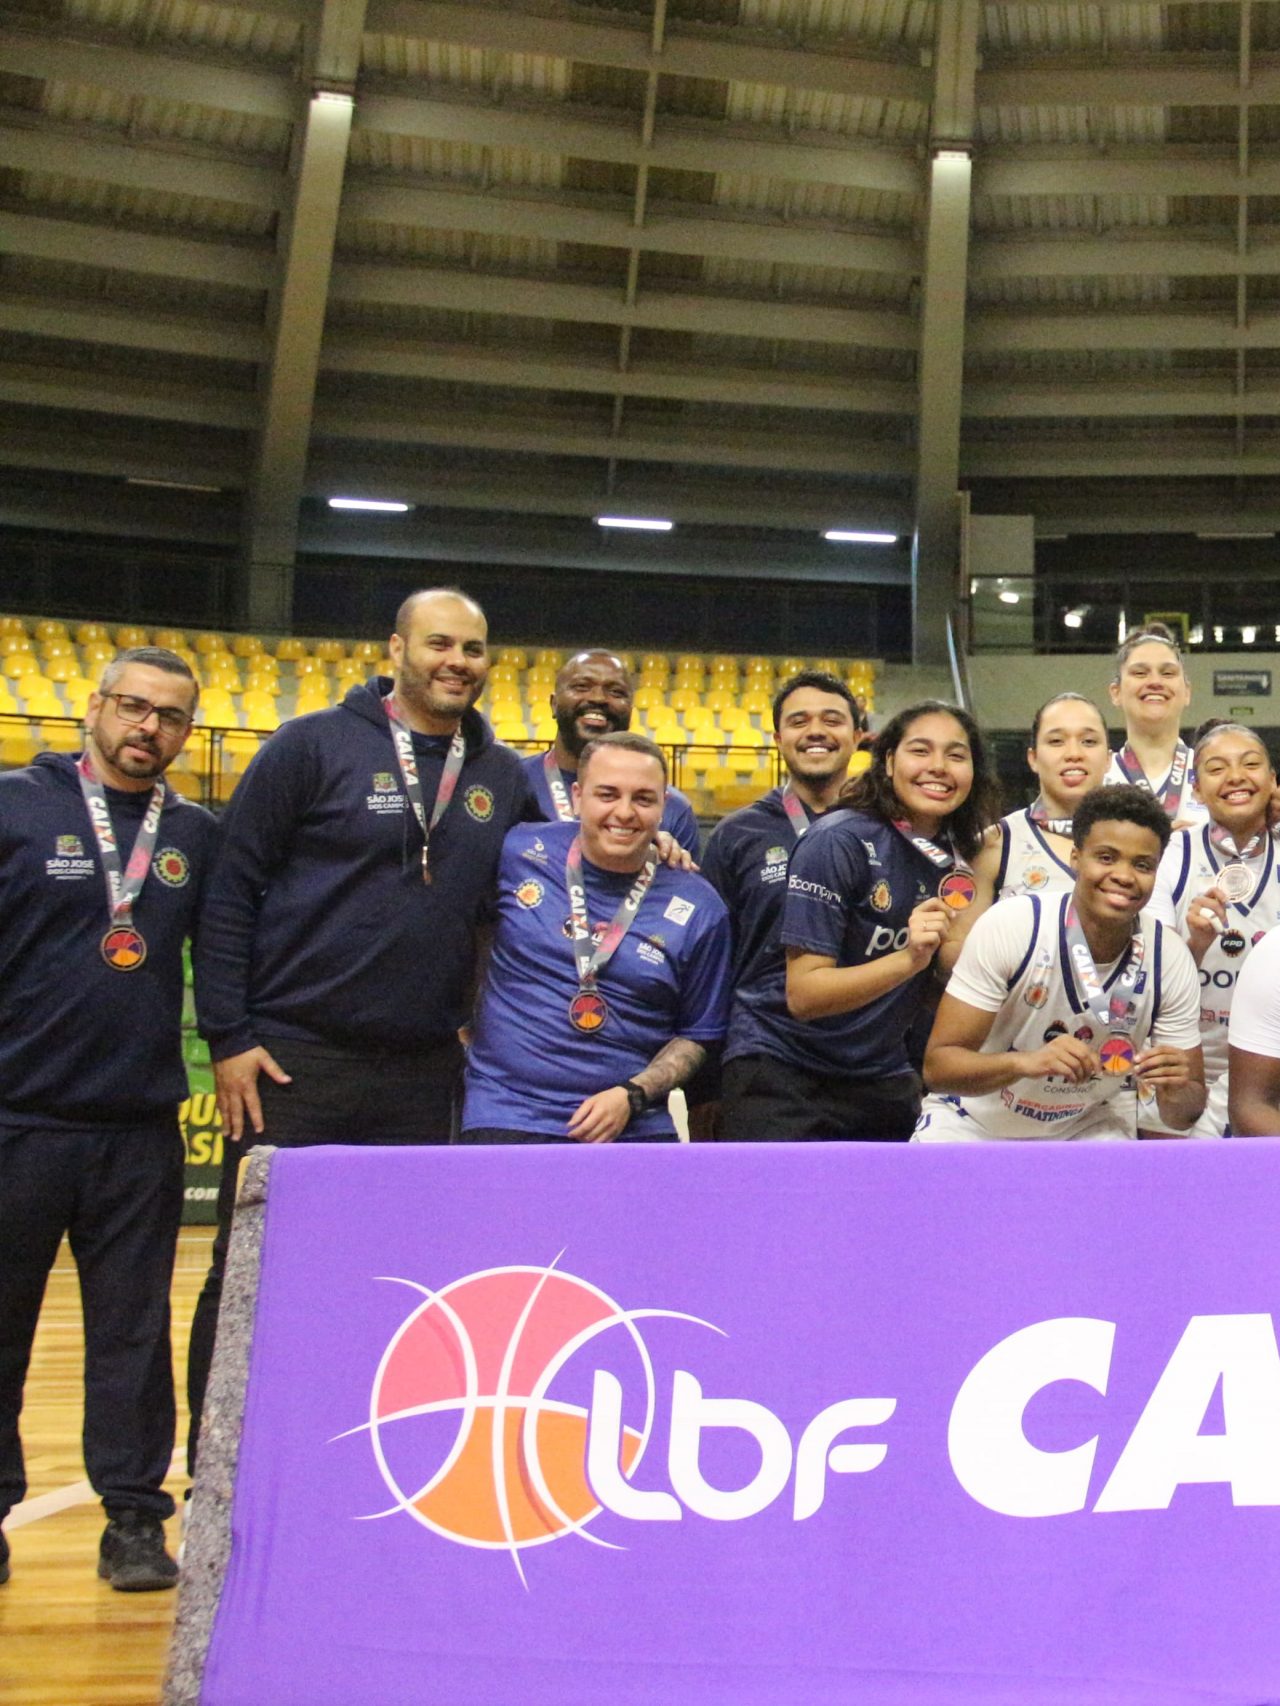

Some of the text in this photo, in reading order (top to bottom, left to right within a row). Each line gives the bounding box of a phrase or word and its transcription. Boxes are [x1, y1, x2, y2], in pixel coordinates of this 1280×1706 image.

[395, 731, 419, 785] CAIXA
[1170, 751, 1187, 786] CAIXA
[88, 796, 117, 853] CAIXA
[912, 837, 948, 863] CAIXA
[46, 858, 69, 868] SÃO
[624, 861, 656, 911] CAIXA
[569, 885, 589, 940] CAIXA
[1071, 943, 1101, 999] CAIXA
[1121, 933, 1145, 987] CAIXA
